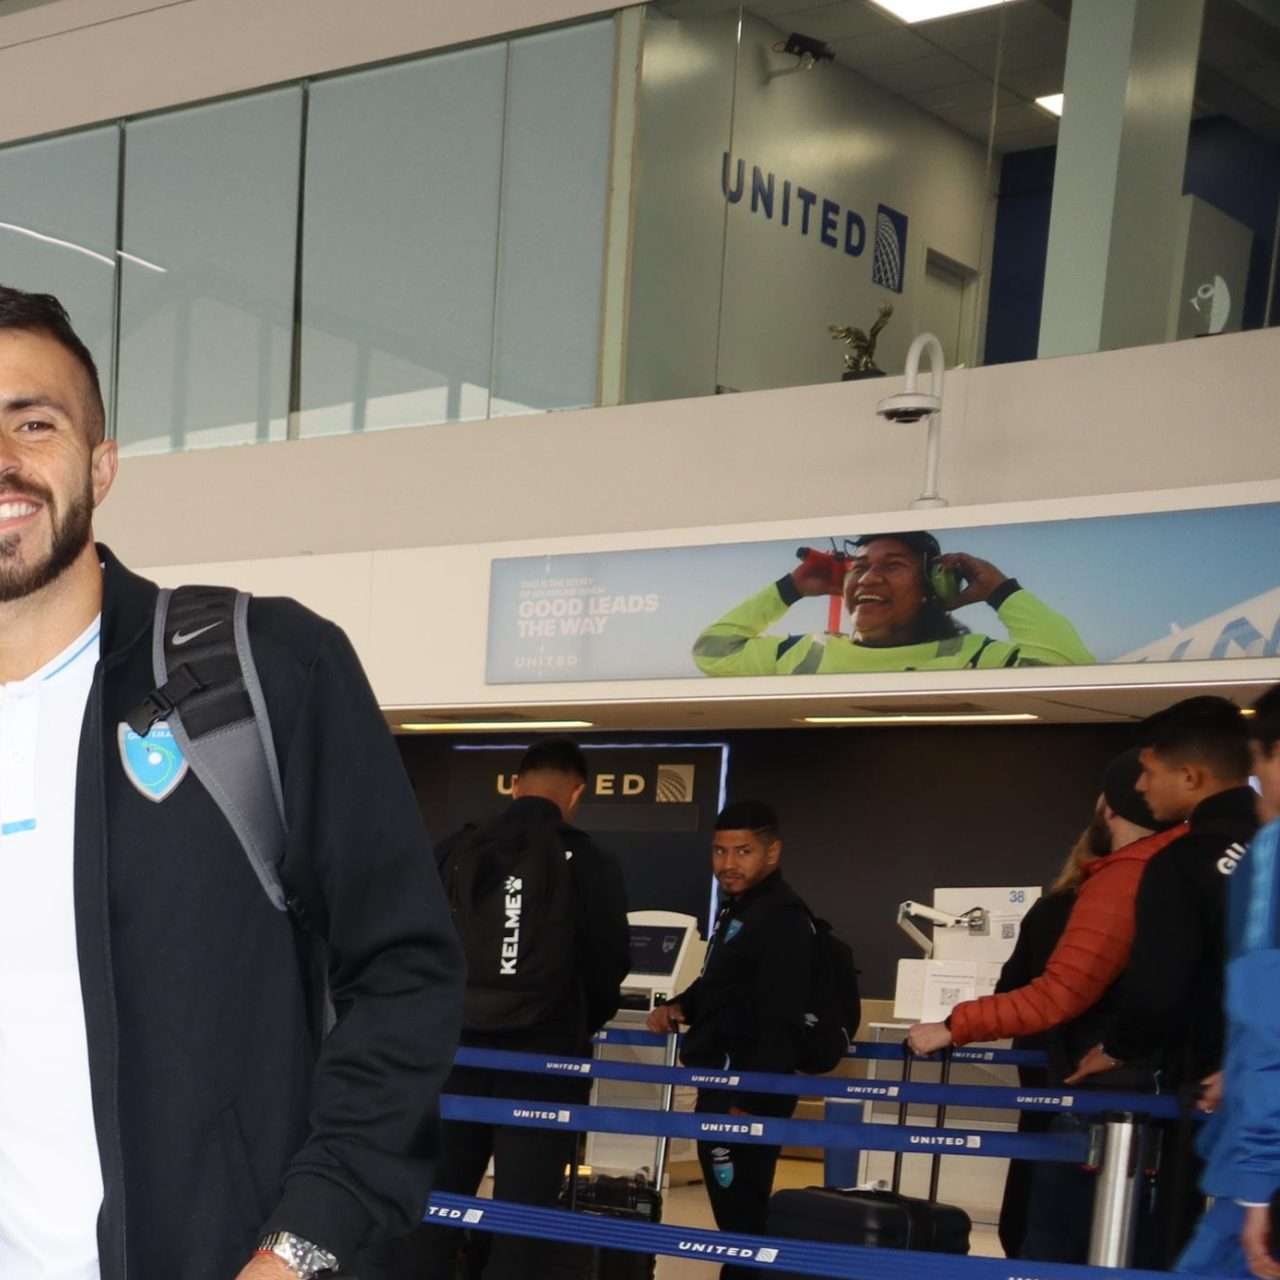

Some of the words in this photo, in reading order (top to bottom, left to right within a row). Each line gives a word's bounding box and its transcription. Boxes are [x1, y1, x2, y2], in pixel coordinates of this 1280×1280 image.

[721, 152, 867, 258] UNITED
[519, 597, 584, 618] GOOD
[589, 593, 659, 615] LEADS
[518, 618, 557, 640] THE
[560, 615, 609, 636] WAY
[514, 654, 579, 669] UNITED
[497, 774, 646, 796] UED
[1008, 890, 1025, 904] 38
[500, 894, 522, 975] KELME
[546, 1062, 581, 1071] UNITED
[691, 1075, 729, 1084] UNITED
[847, 1086, 887, 1095] UNITED
[1016, 1096, 1060, 1105] UNITED
[513, 1109, 556, 1120] UNITED
[701, 1123, 749, 1133] UNITED
[910, 1135, 964, 1146] UNITED
[428, 1206, 461, 1219] TED
[678, 1241, 754, 1258] UNITED
